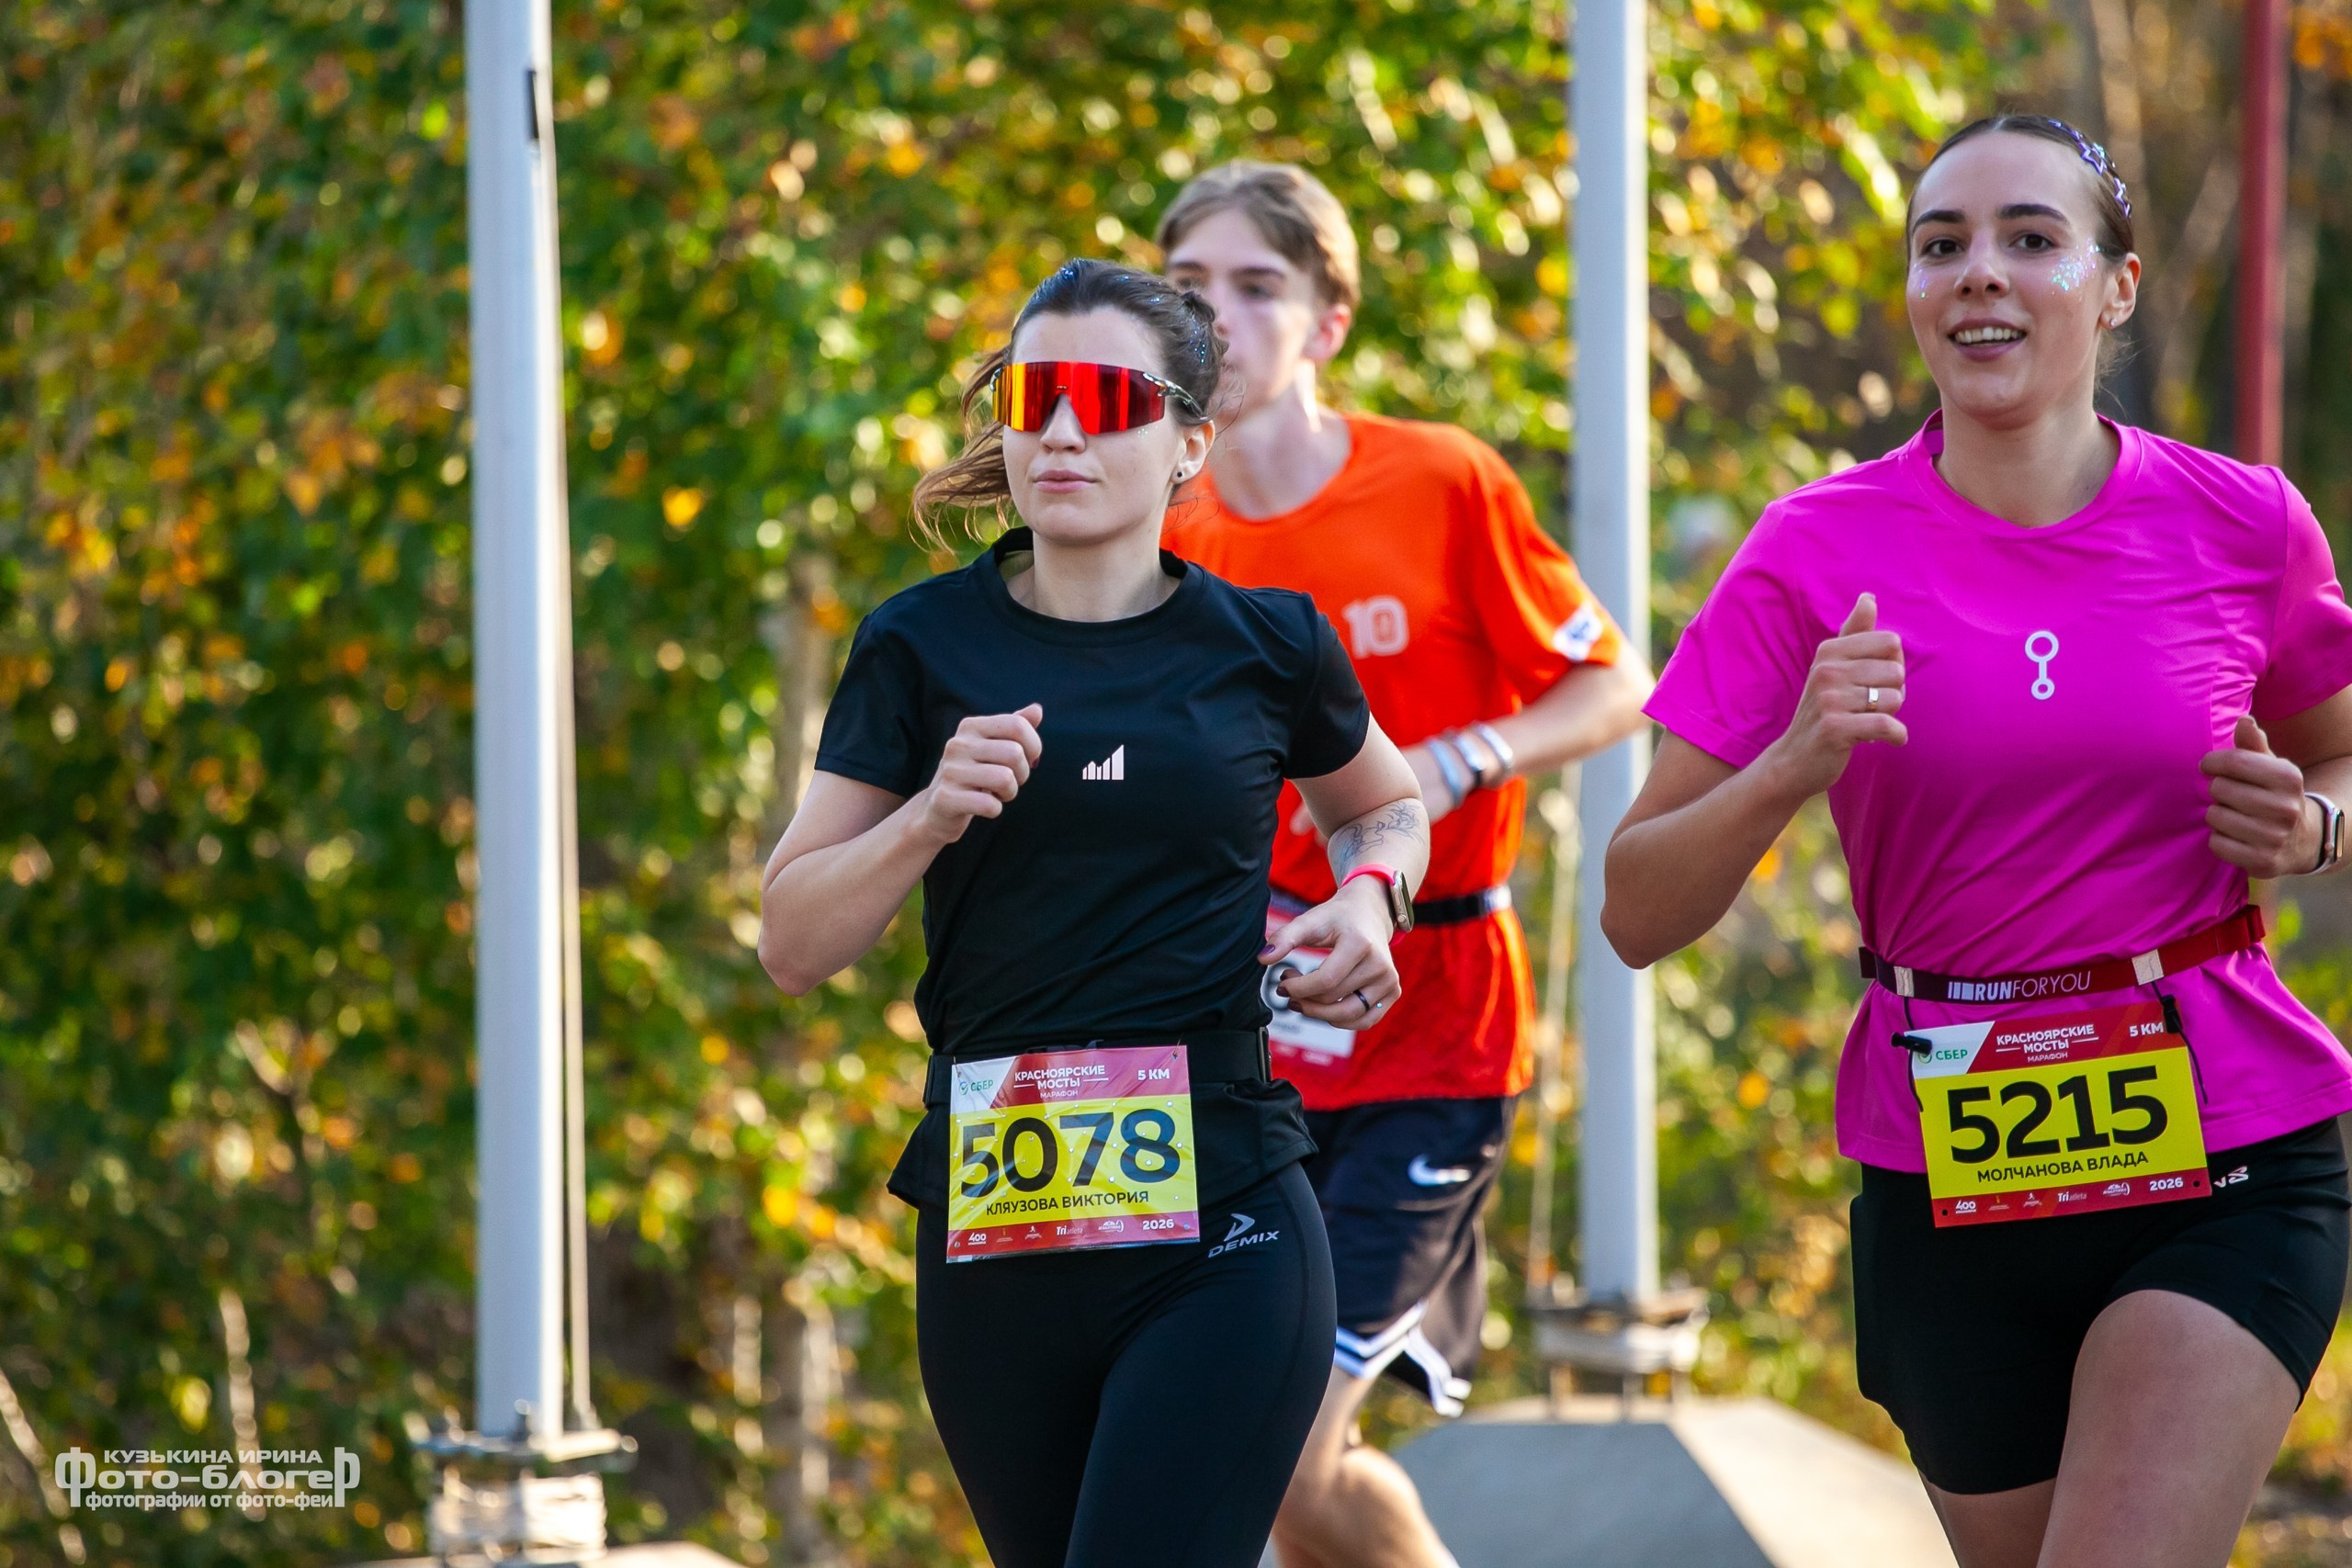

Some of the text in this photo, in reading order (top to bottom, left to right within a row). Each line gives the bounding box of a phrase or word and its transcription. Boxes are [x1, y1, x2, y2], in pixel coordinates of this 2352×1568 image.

[1341, 595, 1409, 660] 10
[1996, 1024, 2095, 1045] КРАСНОЯРСКИЕ
[2129, 1022, 2165, 1037] 5 КМ
[2023, 1039, 2069, 1054] МОСТЫ
[1935, 1049, 1968, 1061] СБЕР
[2027, 1052, 2068, 1063] МАРАФОН
[1014, 1065, 1105, 1081] КРАСНОЯРСКИЕ
[1137, 1068, 1170, 1080] 5 КМ
[970, 1079, 994, 1091] СБЕР
[1037, 1077, 1080, 1090] МОСТЫ
[1040, 1089, 1079, 1099] МАРАФОН
[1947, 1066, 2168, 1163] 5215
[960, 1109, 1181, 1198] 5078
[1977, 1152, 2149, 1183] МОЛЧАНОВА ВЛАДА
[2149, 1178, 2184, 1191] 2026
[986, 1191, 1148, 1215] КЛЯУЗОВА ВИКТОРИЯ
[1955, 1199, 1976, 1211] 400
[1142, 1219, 1174, 1230] 2026
[968, 1232, 987, 1242] 400
[1207, 1231, 1280, 1258] DEMIX
